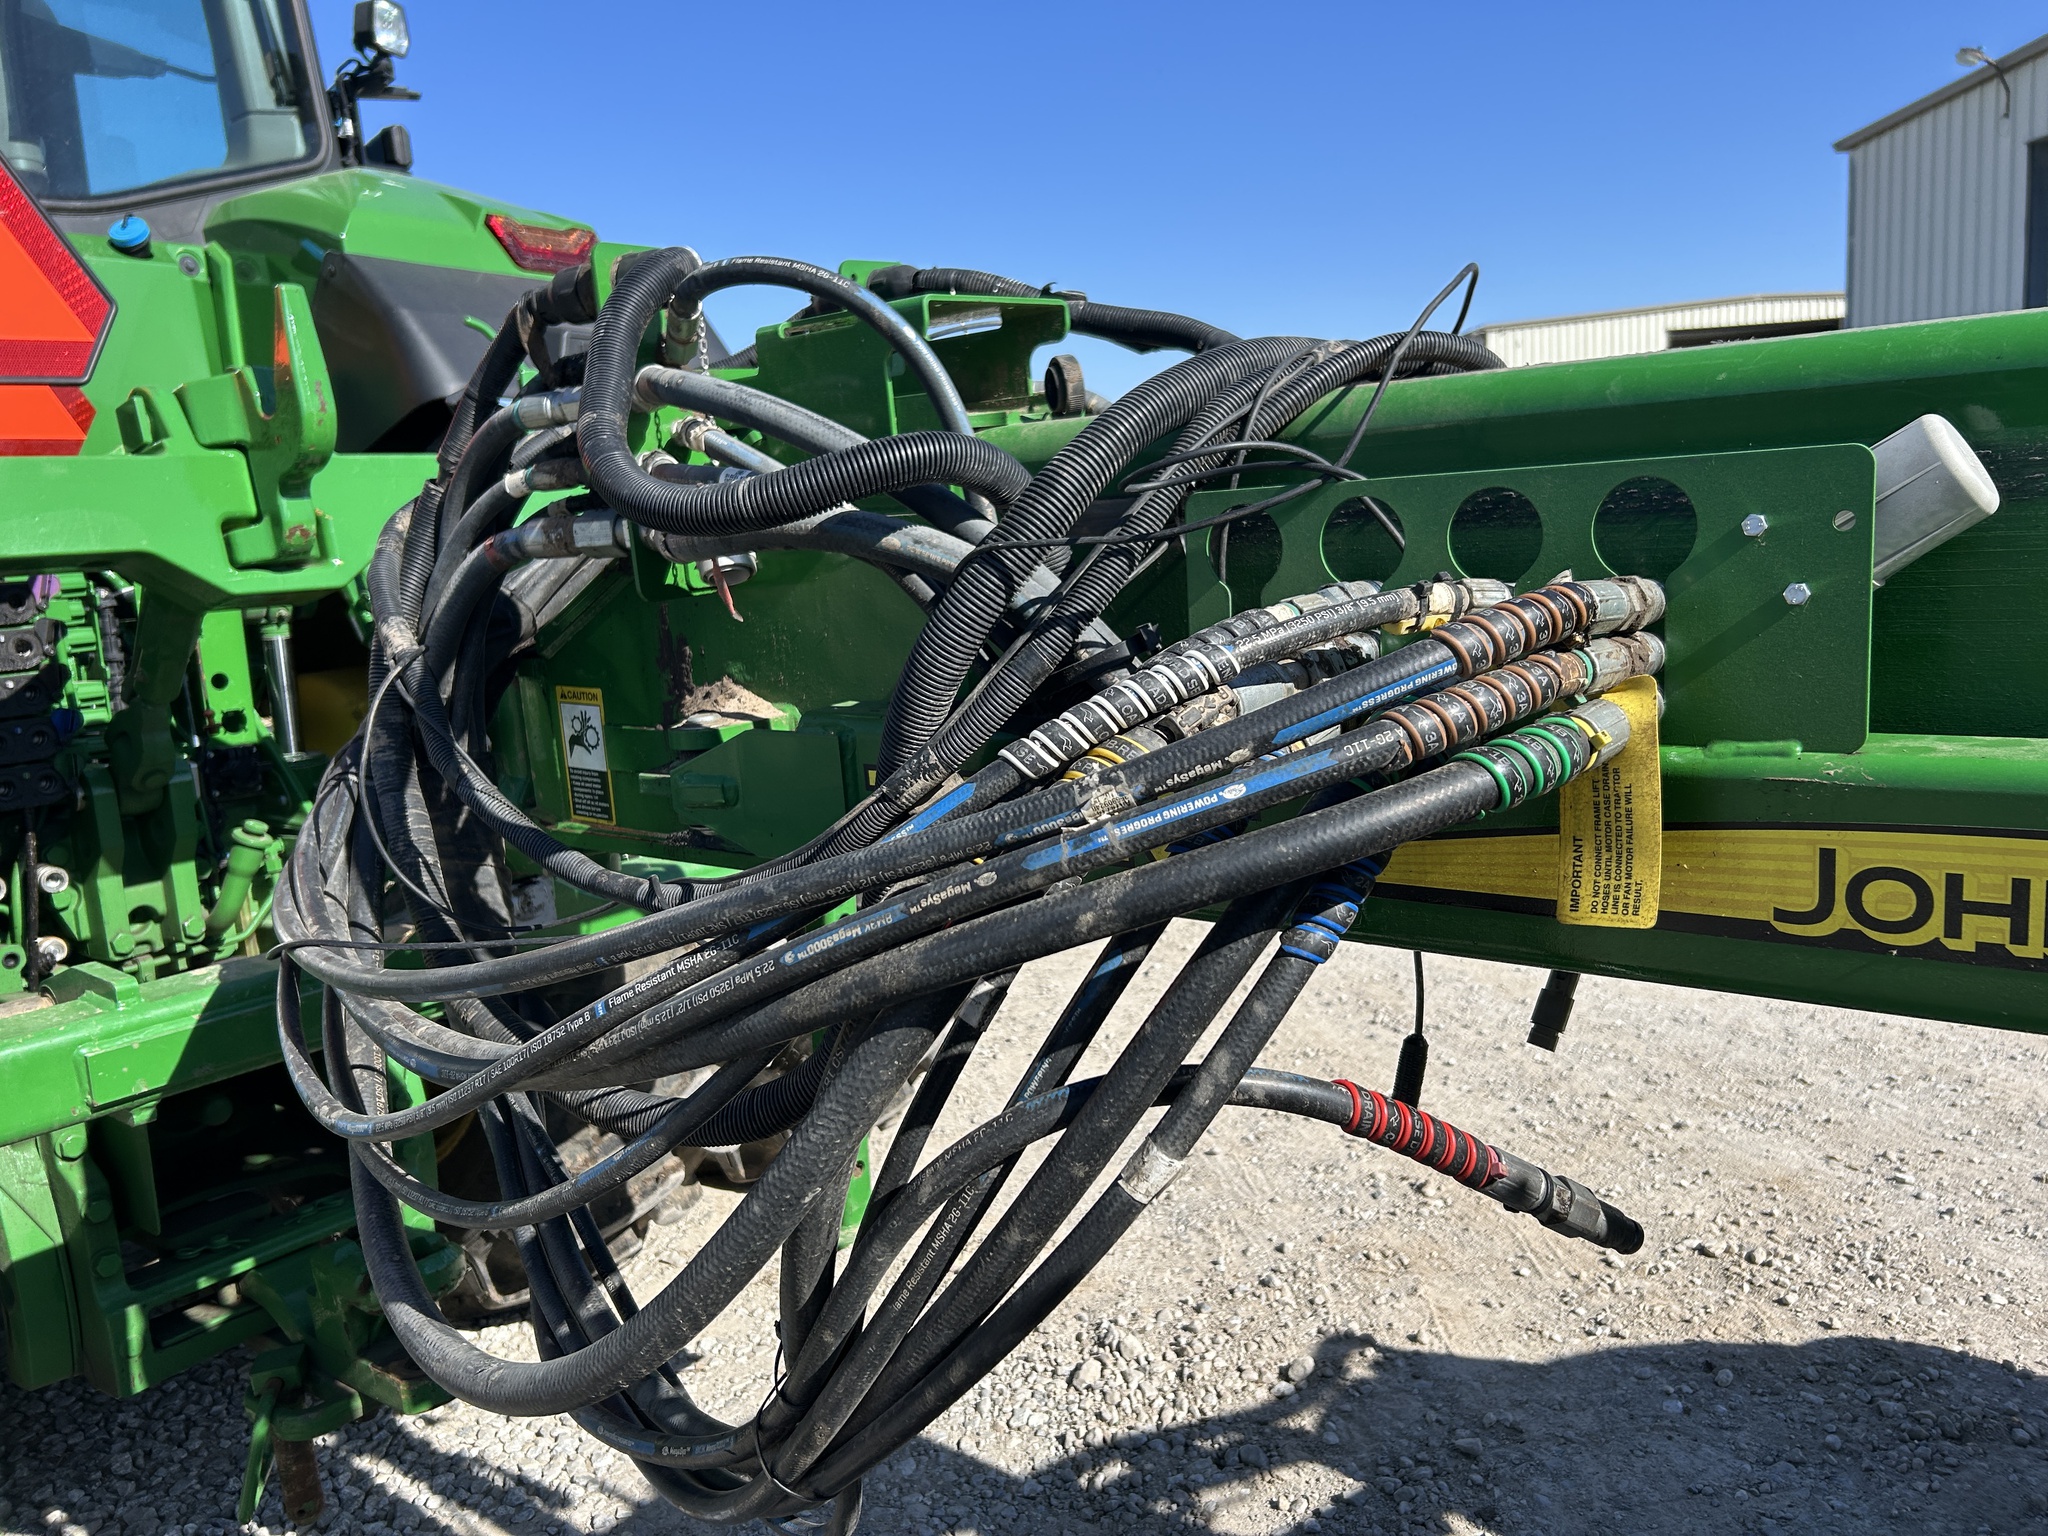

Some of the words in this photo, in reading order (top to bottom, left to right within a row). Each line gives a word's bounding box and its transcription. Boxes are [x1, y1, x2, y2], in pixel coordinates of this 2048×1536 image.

[754, 256, 795, 269] Resistant
[1236, 634, 1262, 648] 22.5
[1261, 627, 1285, 643] MPa
[1415, 661, 1459, 688] OWERING
[567, 690, 599, 702] CAUTION
[1134, 674, 1168, 706] LOAD
[1114, 699, 1139, 722] LOA
[1592, 779, 1601, 801] LIFT
[1601, 761, 1610, 797] DRAIN
[1163, 794, 1219, 819] POWERING
[1625, 783, 1633, 806] WILL
[1593, 801, 1602, 833] FRAME
[1603, 796, 1612, 822] CASE
[1615, 812, 1622, 827] TO
[1604, 823, 1612, 855] MOTOR
[1625, 807, 1633, 846] FAILURE
[1593, 833, 1602, 878] CONNECT
[1614, 827, 1623, 882] CONNECTED
[1625, 847, 1634, 880] MOTOR
[1569, 836, 1583, 912] IMPORTANT
[1604, 855, 1612, 881] UNTIL
[1592, 879, 1601, 899] NOT
[1601, 884, 1611, 915] HOSES
[1613, 883, 1621, 891] IS
[1623, 881, 1631, 901] FAN
[1773, 847, 2048, 949] JOH
[1590, 899, 1599, 914] DO
[1611, 891, 1619, 915] LINE
[1622, 903, 1630, 916] OR
[736, 969, 756, 984] MPa
[754, 959, 775, 977] 22.5
[458, 1082, 475, 1100] 11237
[474, 1076, 487, 1089] R17
[490, 1065, 503, 1078] SAE
[530, 1040, 543, 1054] ISO
[543, 1025, 566, 1047] 18752
[565, 1018, 584, 1033] Type
[584, 1011, 591, 1022] B
[608, 988, 635, 1009] Flame
[635, 966, 676, 995] Resistant
[676, 954, 704, 974] MSHA
[703, 934, 740, 960] 2G-11C
[905, 1248, 937, 1291] Resistant
[930, 1222, 953, 1251] MSHA
[947, 1185, 976, 1224] 2G-11C
